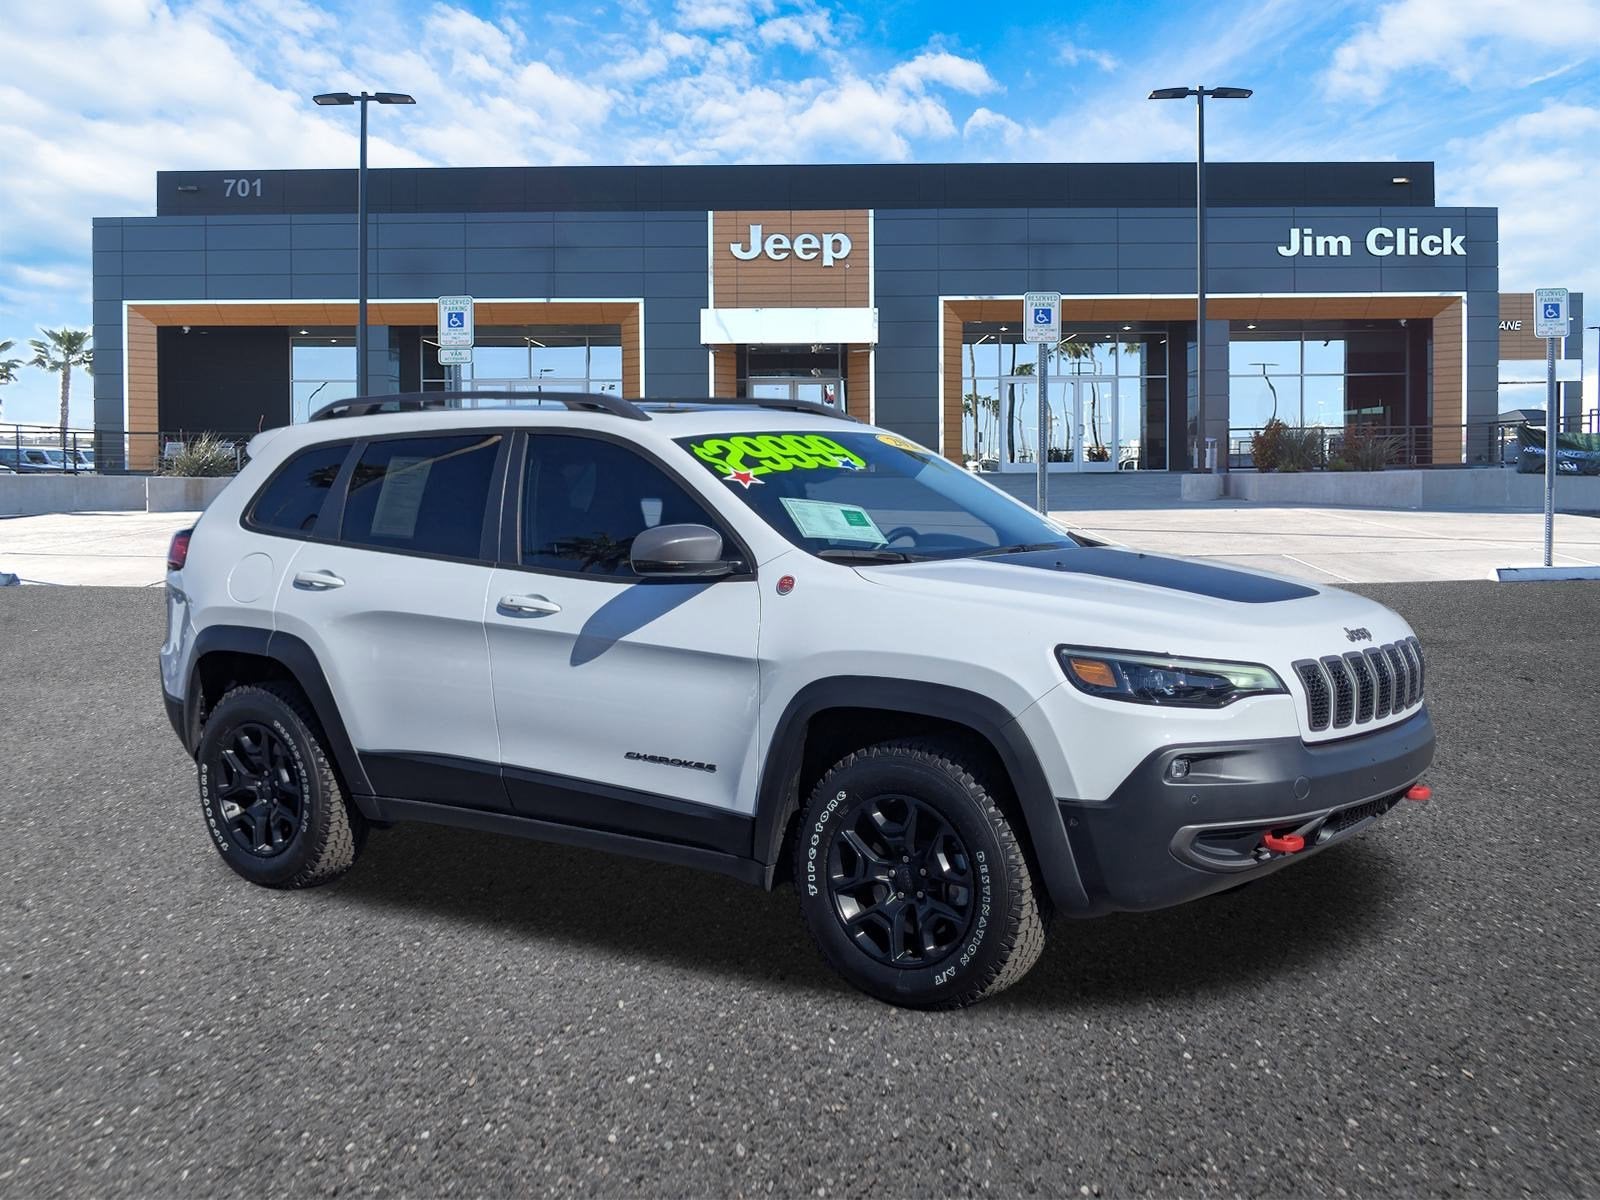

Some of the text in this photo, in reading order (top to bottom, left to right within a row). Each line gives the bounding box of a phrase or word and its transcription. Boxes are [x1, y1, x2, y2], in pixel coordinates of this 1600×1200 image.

[223, 178, 262, 197] 701
[729, 223, 853, 268] Jeep
[1276, 227, 1467, 257] Jim Click
[1343, 627, 1373, 643] Jeep
[623, 751, 718, 774] CHEROKEE
[933, 850, 992, 986] DESTINATION A/T
